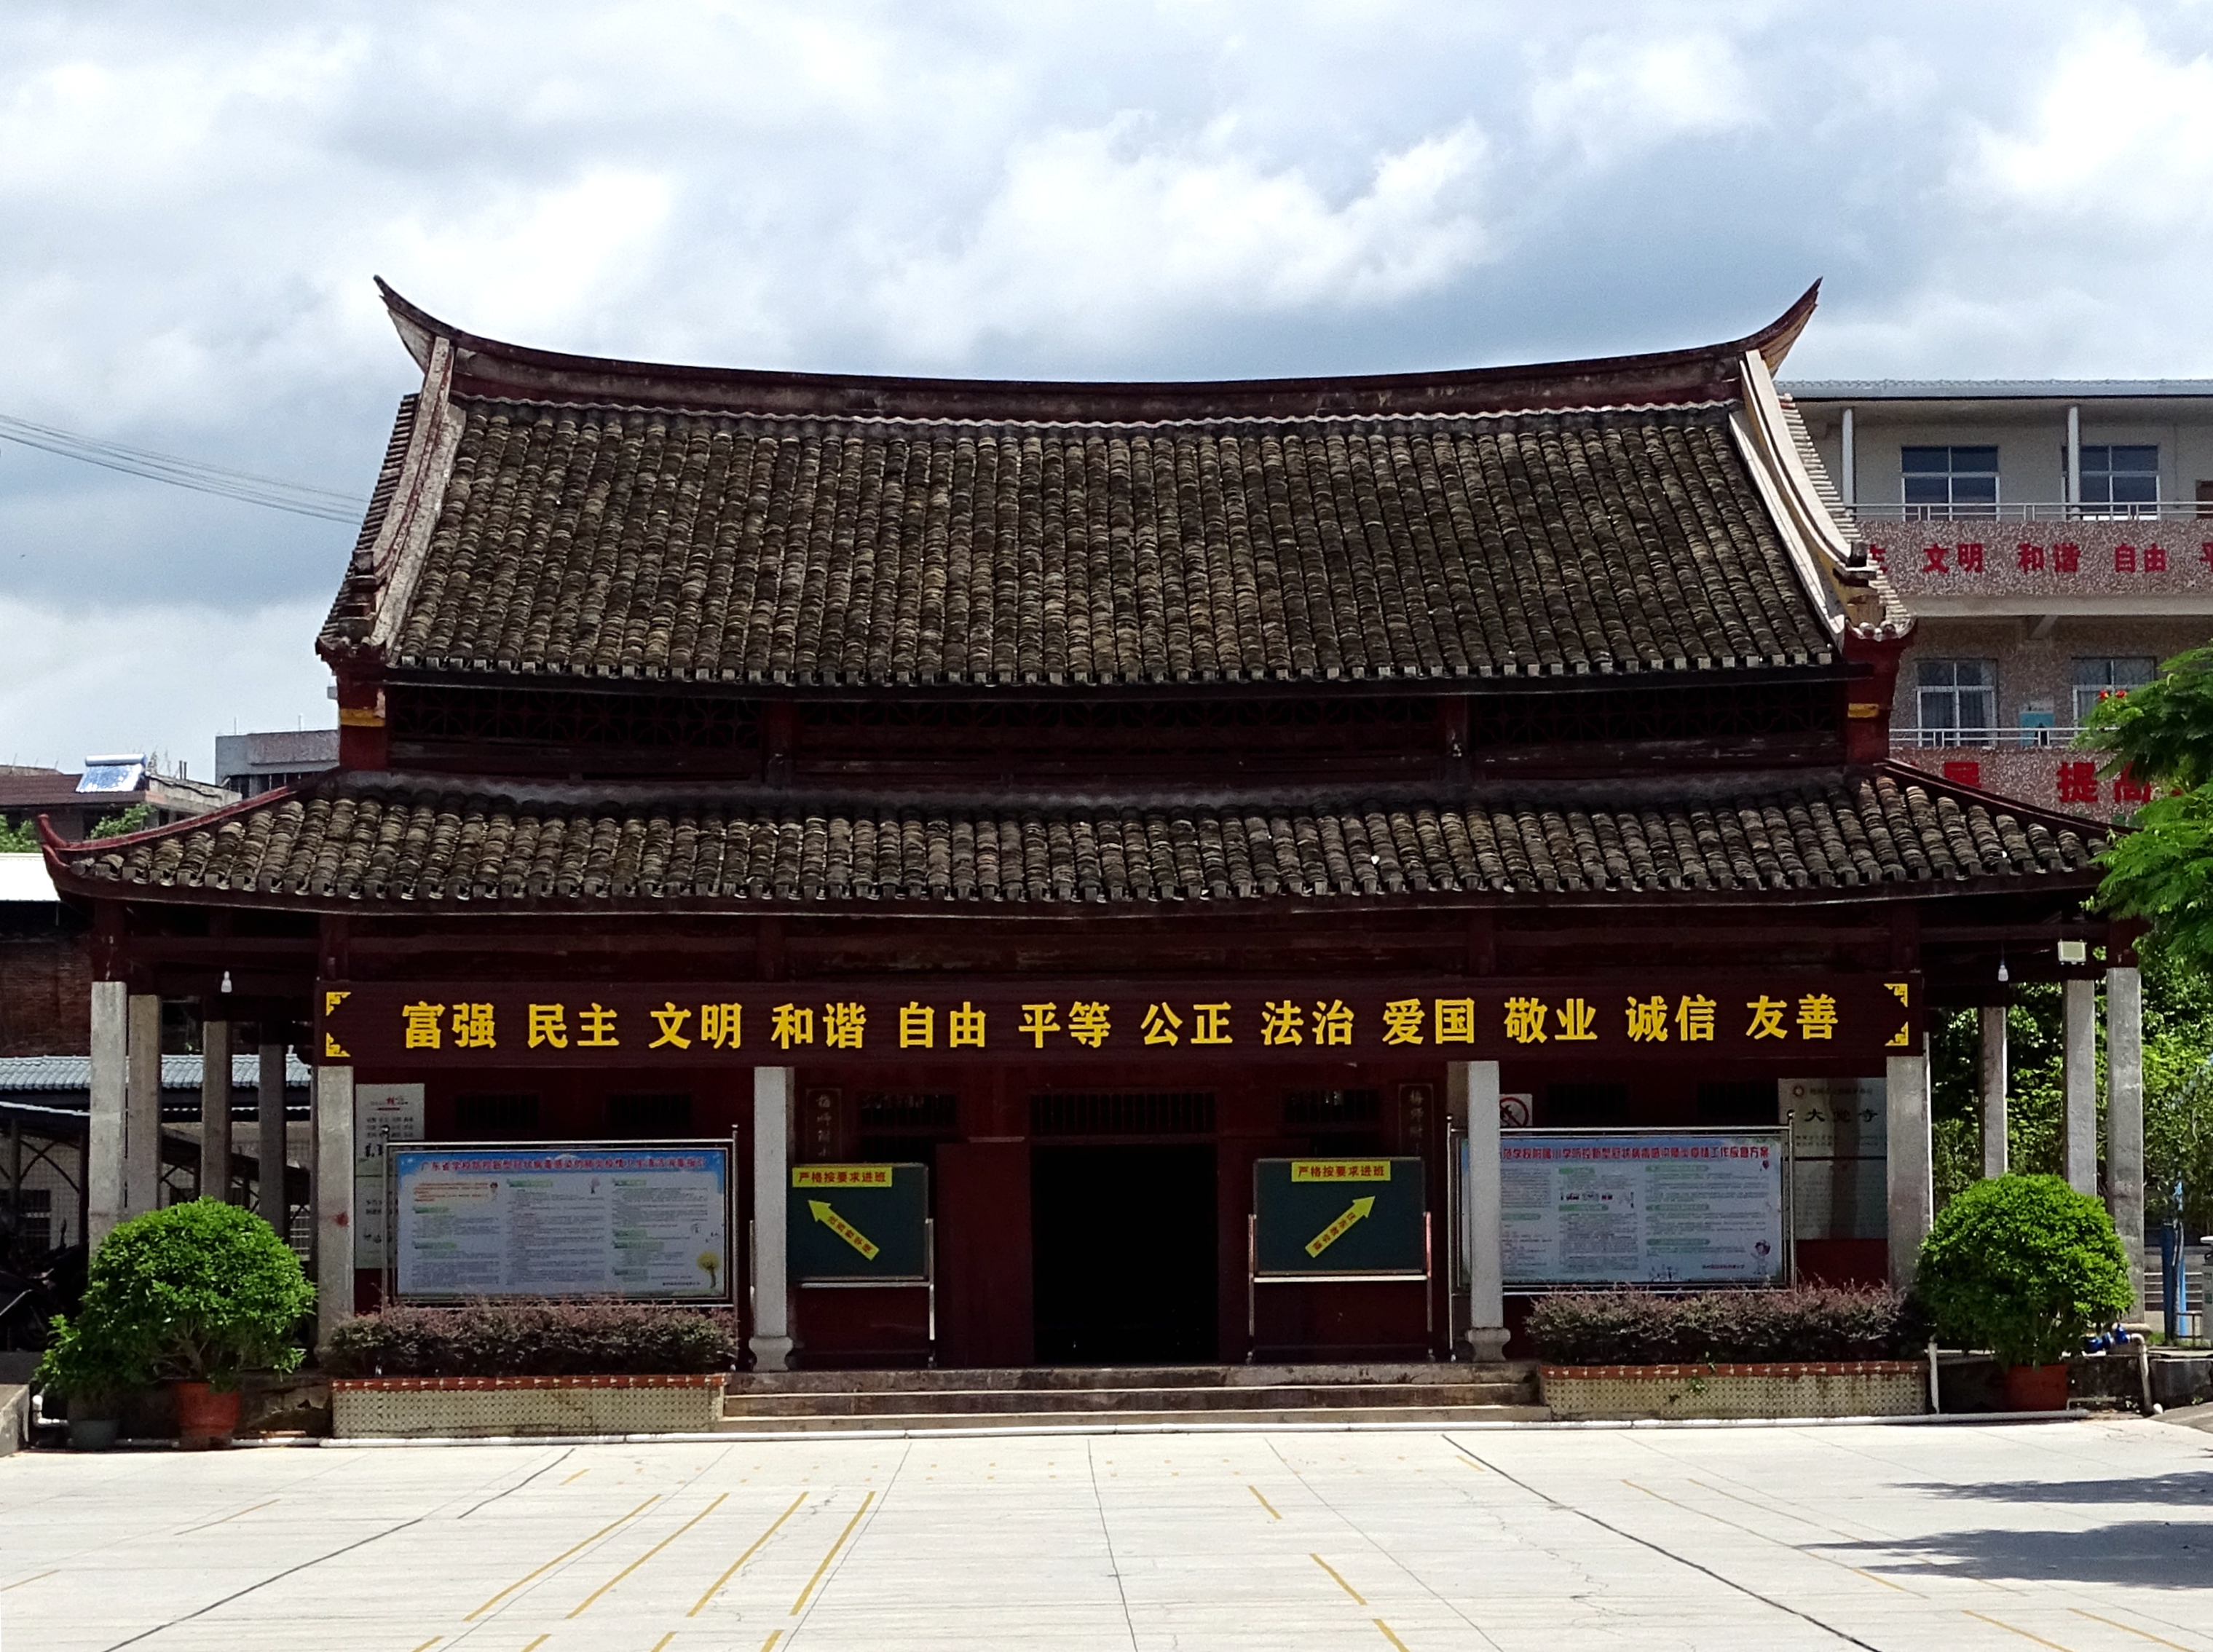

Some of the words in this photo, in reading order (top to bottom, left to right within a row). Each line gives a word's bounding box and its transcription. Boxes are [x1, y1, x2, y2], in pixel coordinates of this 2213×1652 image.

[1922, 543, 1983, 573] 文明
[2017, 542, 2080, 573] 和谐
[2115, 542, 2167, 573] 自由
[402, 1000, 497, 1049] 富强
[527, 1002, 620, 1049] 民主
[650, 1002, 743, 1049] 文明
[771, 1002, 867, 1050] 和谐
[899, 1001, 987, 1048] 自由
[1019, 1001, 1112, 1048] 平等
[1141, 1001, 1233, 1046] 公正
[1262, 1000, 1355, 1046] 法治
[1382, 997, 1475, 1046] 爱国
[1504, 996, 1598, 1044] 敬业
[1625, 994, 1717, 1043] 诚信
[1745, 993, 1839, 1040] 友善
[799, 1171, 886, 1182] 严格按要求进班
[1298, 1165, 1384, 1177] 严格按要求进班
